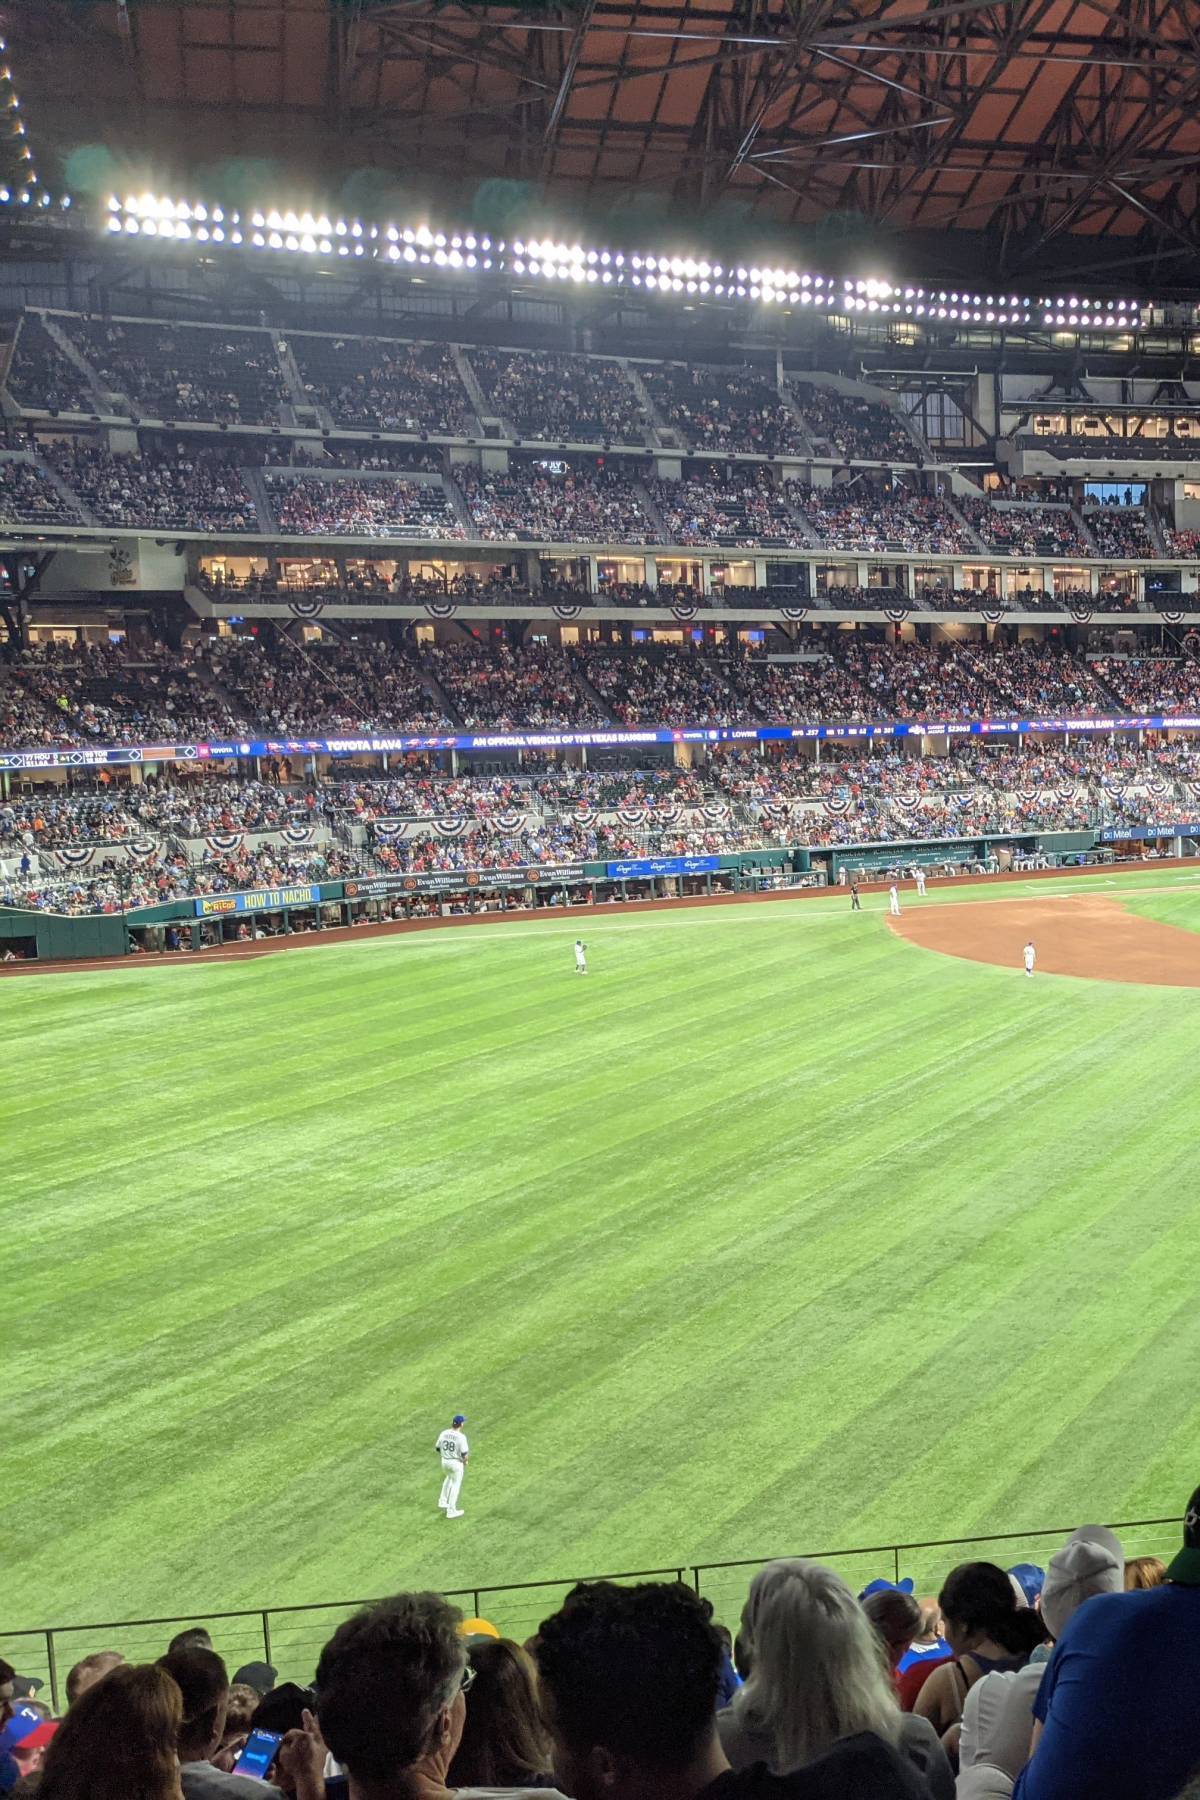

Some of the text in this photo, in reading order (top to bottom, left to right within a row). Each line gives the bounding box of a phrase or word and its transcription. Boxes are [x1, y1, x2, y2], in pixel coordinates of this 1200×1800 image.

[1066, 720, 1095, 729] TOYOTA
[326, 739, 402, 751] TOYOTA RAV4
[473, 733, 657, 746] AN OFFICIAL VEHICLE OF THE TEXAS RANGERS
[1113, 829, 1132, 839] Mitel
[1157, 826, 1175, 836] Mitel
[244, 896, 266, 909] HOW
[268, 893, 281, 906] TO
[442, 1440, 456, 1452] 38
[21, 1707, 38, 1721] T
